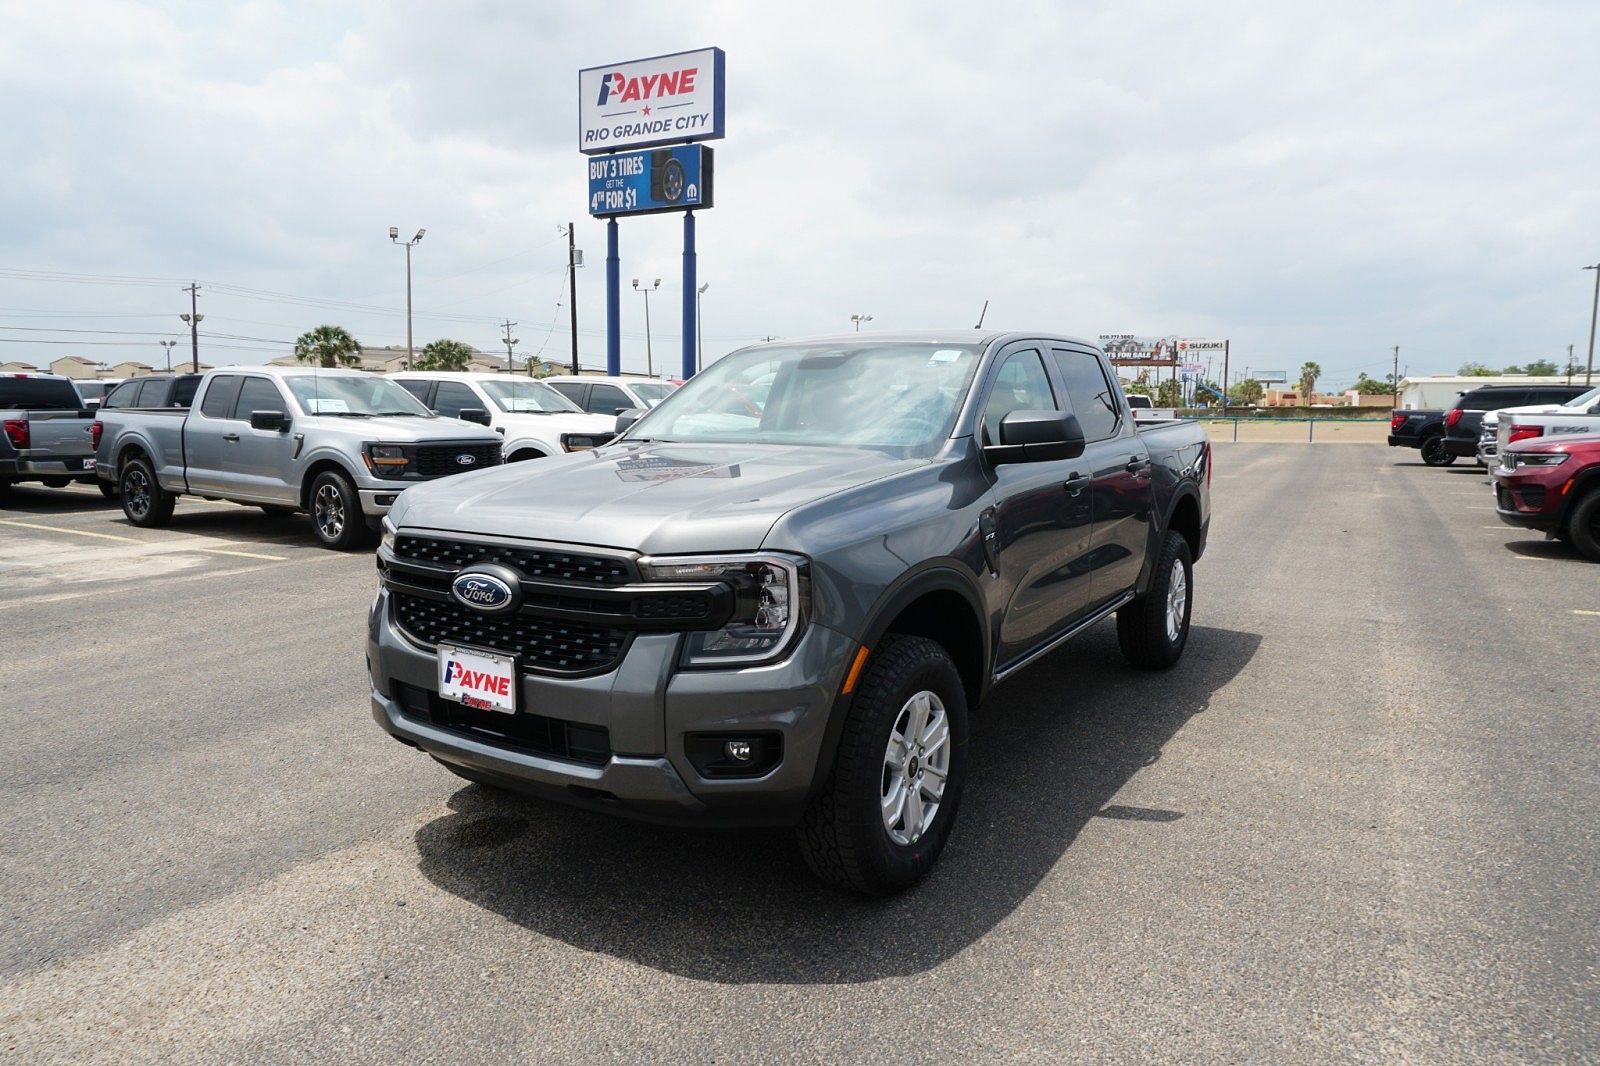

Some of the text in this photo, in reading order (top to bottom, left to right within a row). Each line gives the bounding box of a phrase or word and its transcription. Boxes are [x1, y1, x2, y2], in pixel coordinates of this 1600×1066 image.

[597, 68, 698, 106] PAYNE
[585, 113, 709, 142] RIO GRANDE CITY
[590, 156, 644, 180] BUY 3 TIRES
[606, 178, 624, 188] GET THE
[591, 186, 637, 210] 4TH FOR $1
[463, 580, 496, 603] Ford
[444, 660, 511, 696] PAYNE
